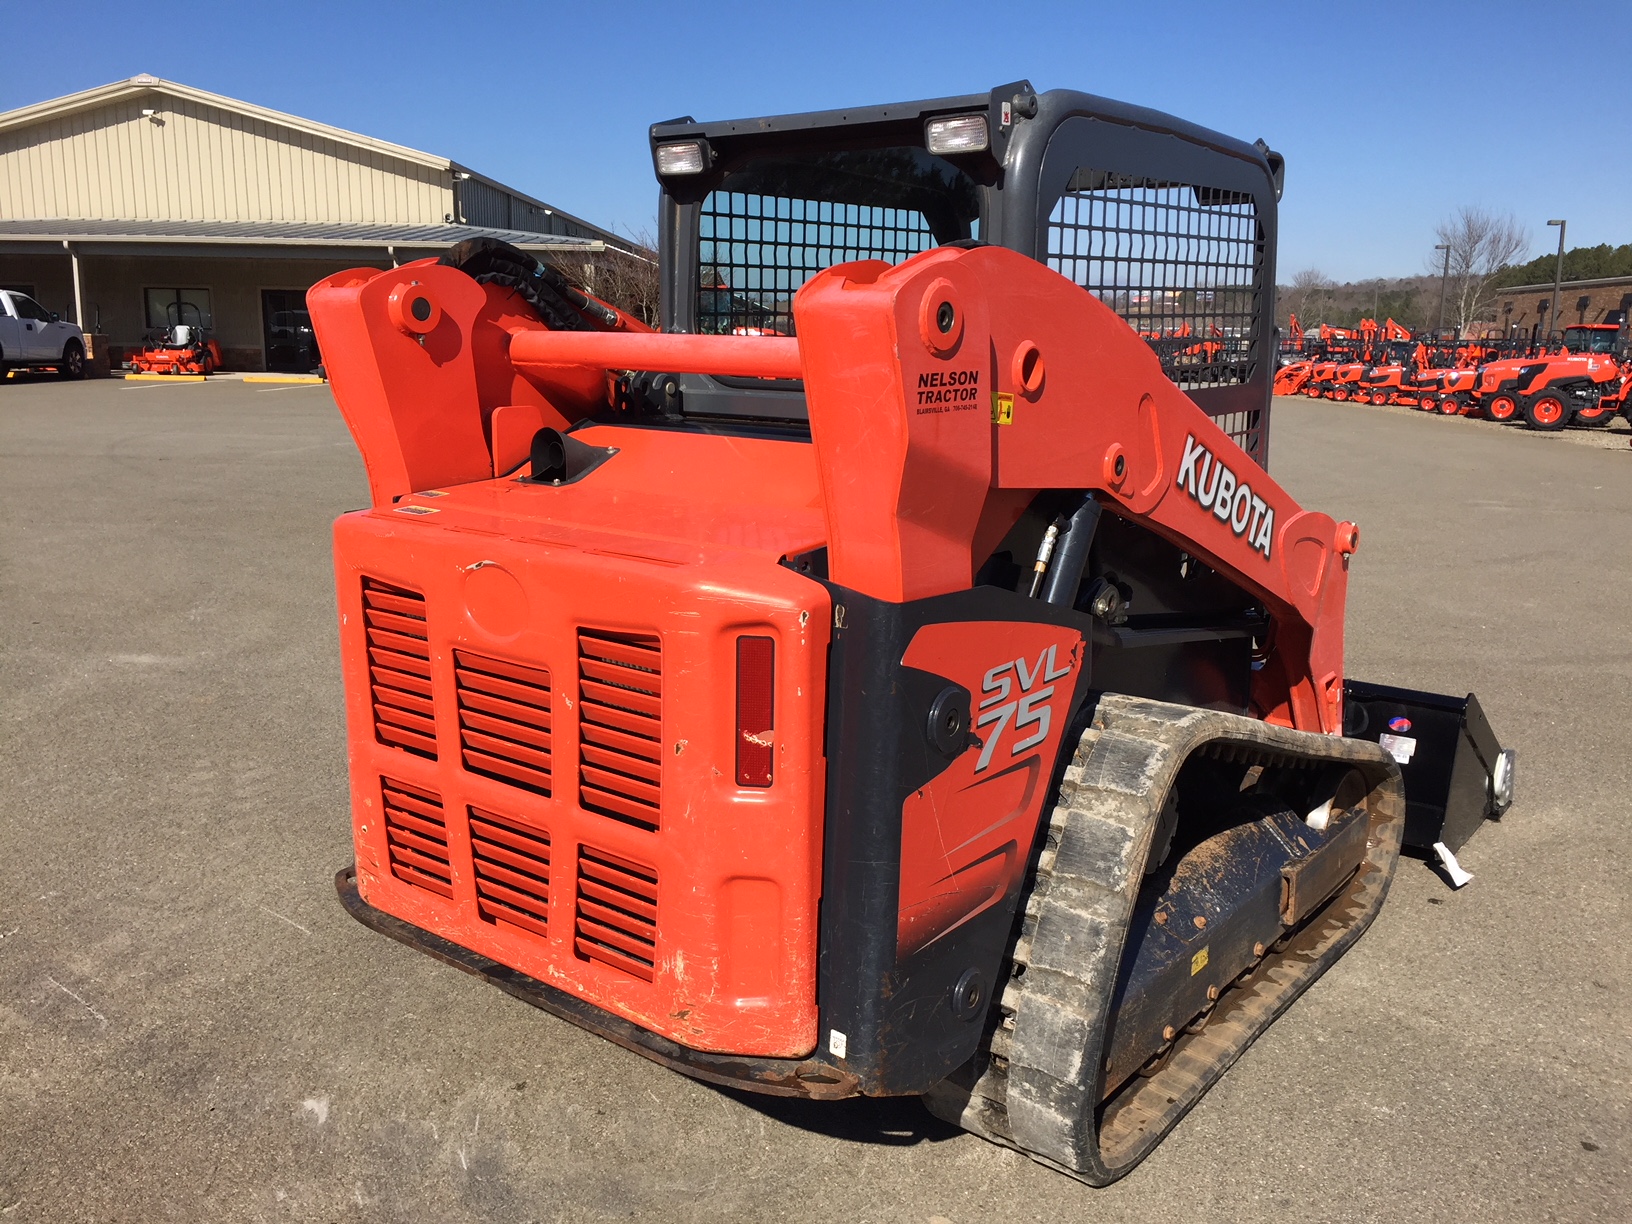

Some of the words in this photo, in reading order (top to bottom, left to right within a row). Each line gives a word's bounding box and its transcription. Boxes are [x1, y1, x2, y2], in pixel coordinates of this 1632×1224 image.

[917, 388, 977, 404] TRACTOR
[918, 370, 978, 388] NELSON
[1176, 433, 1275, 559] KUBOTA
[978, 643, 1072, 711] SVL
[973, 684, 1055, 775] 75
